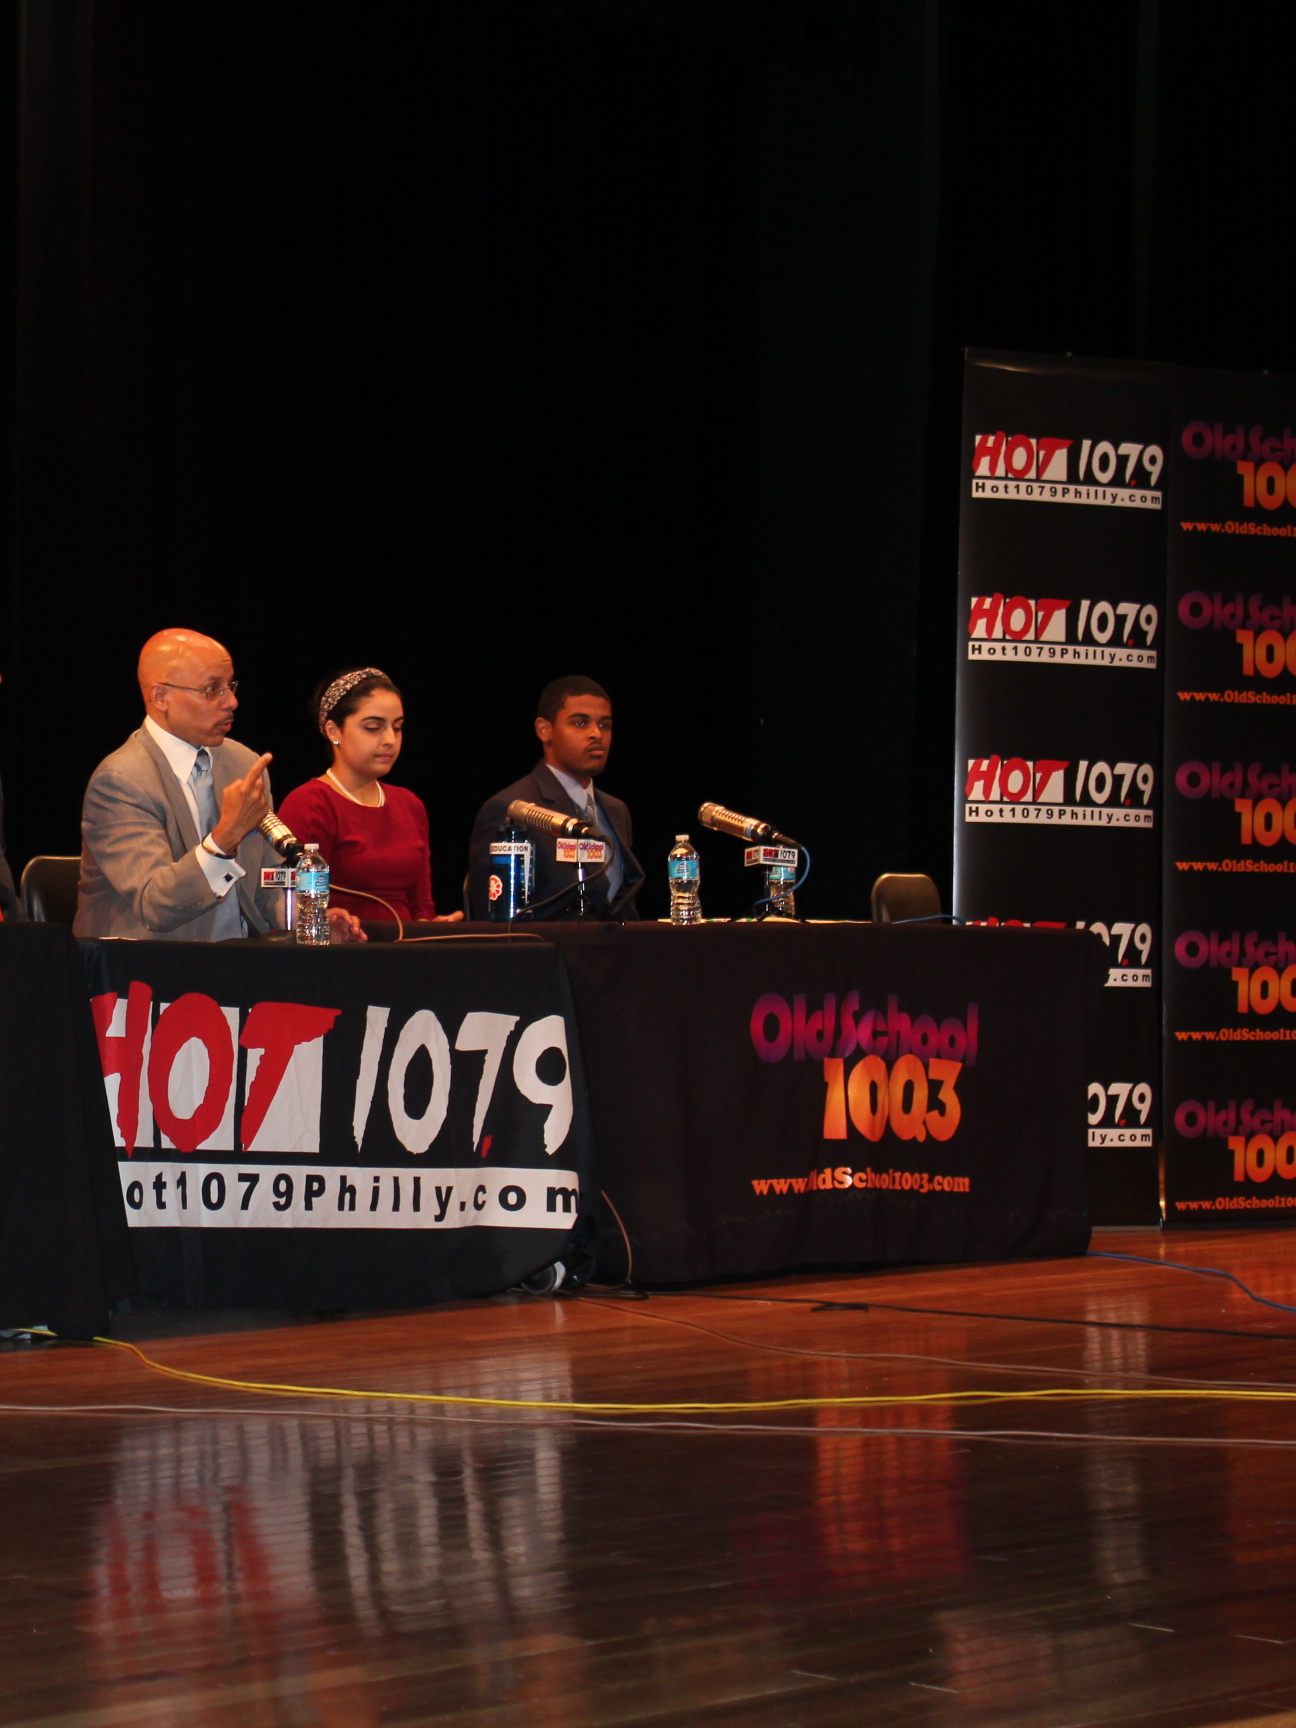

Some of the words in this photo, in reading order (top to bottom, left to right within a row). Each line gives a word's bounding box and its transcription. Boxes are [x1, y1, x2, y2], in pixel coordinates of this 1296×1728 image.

[972, 431, 1074, 482] HOT
[974, 481, 1161, 506] Hot1079Philly.com
[968, 593, 1072, 641] HOT
[970, 644, 1156, 665] Hot1079Philly.com
[965, 755, 1071, 803] HOT
[968, 806, 1152, 824] Hot1079Philly.com
[90, 981, 342, 1158] HOT
